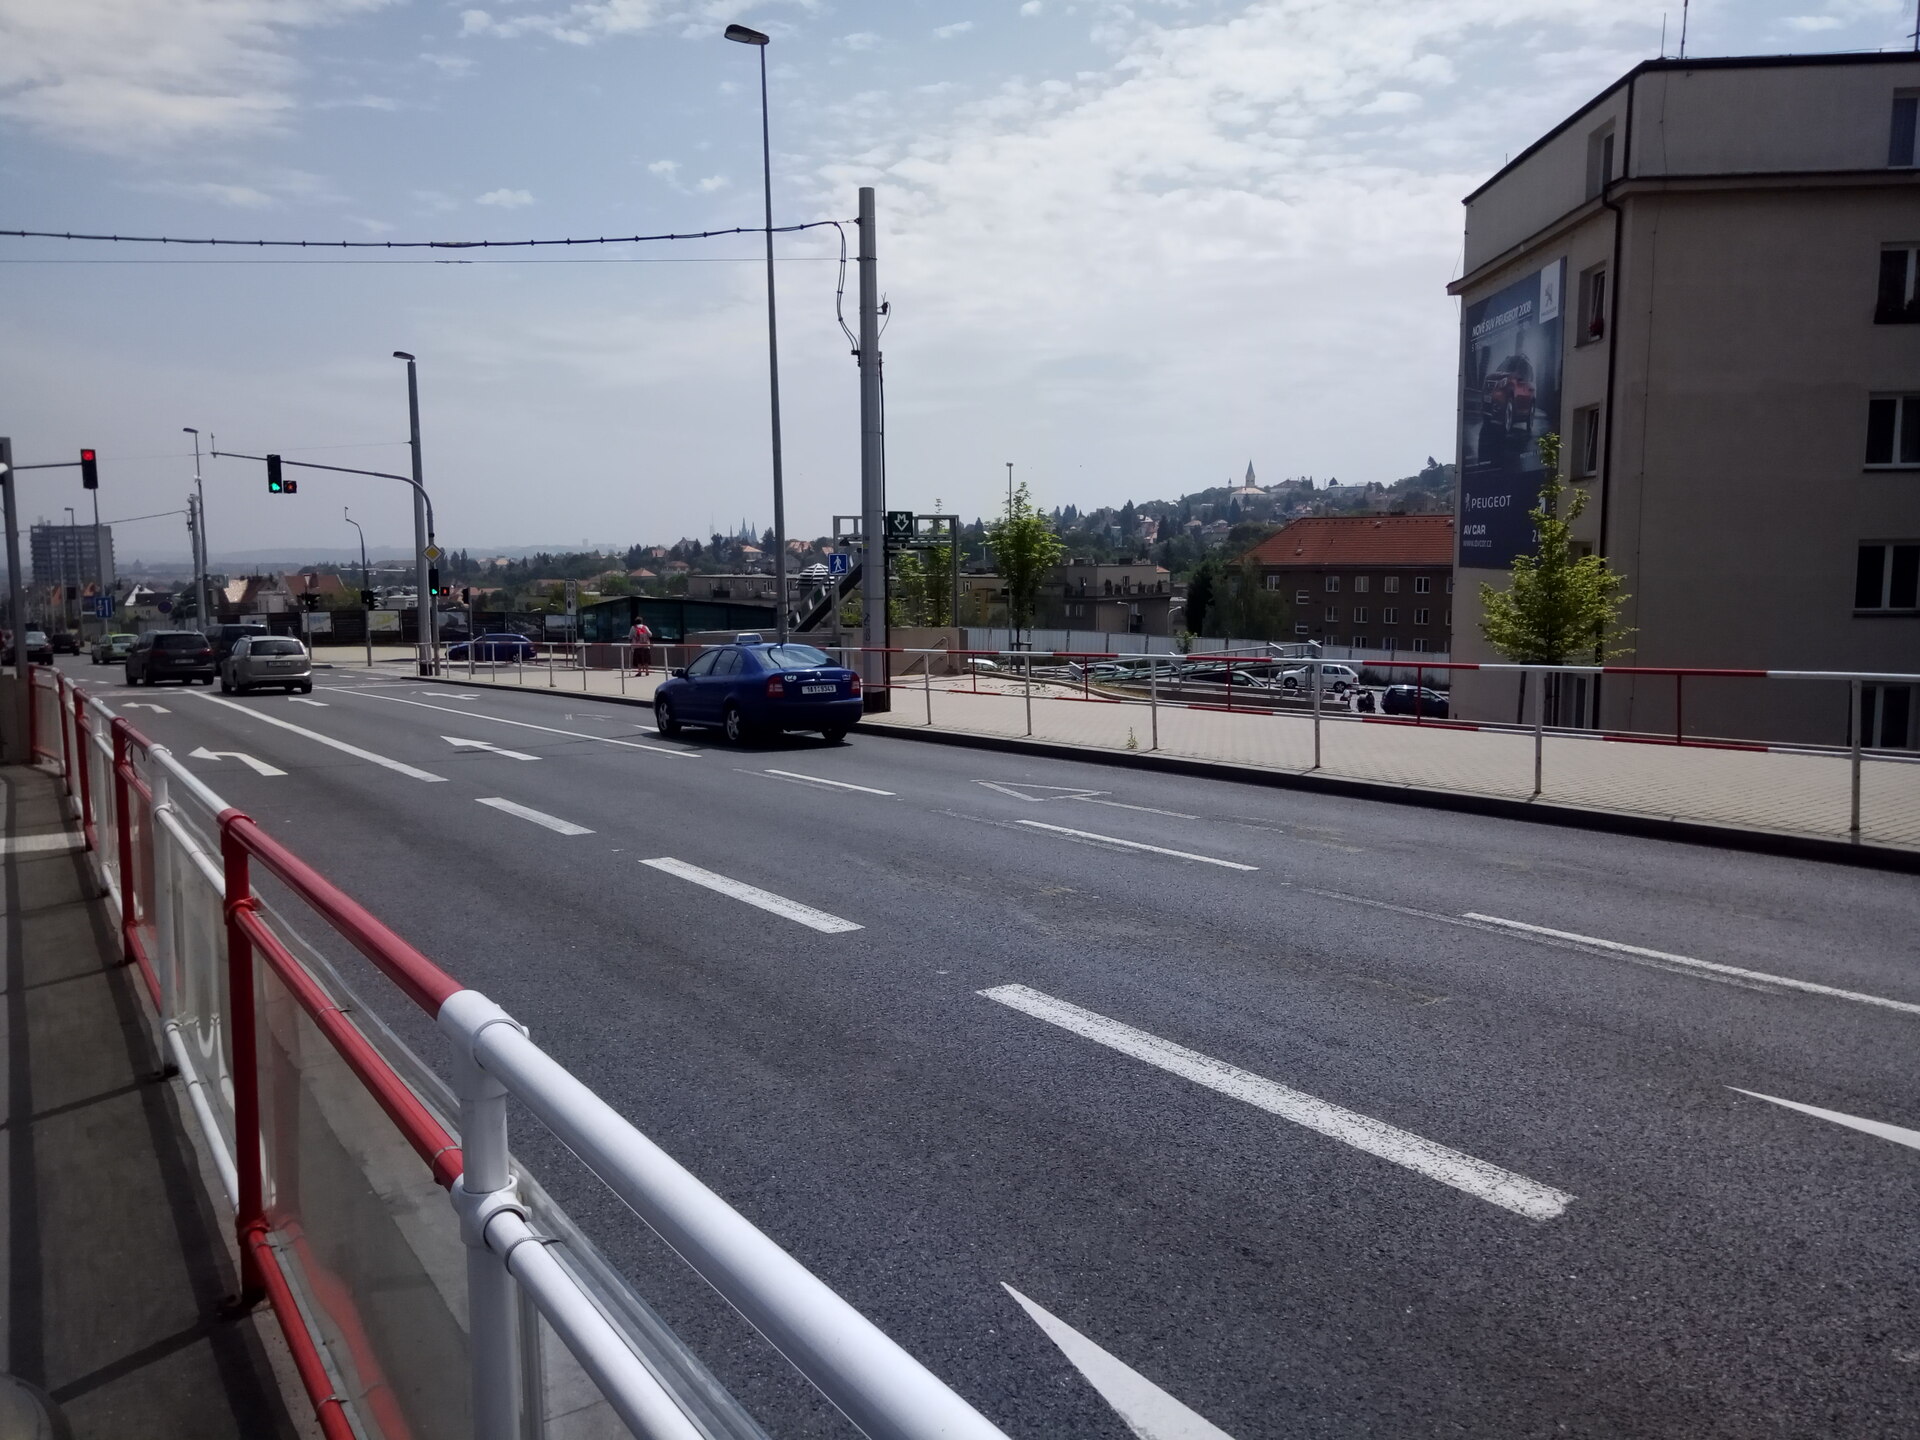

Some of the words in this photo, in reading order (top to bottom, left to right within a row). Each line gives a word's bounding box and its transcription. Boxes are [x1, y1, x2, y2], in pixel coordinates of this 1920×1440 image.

[1496, 306, 1519, 326] PEUGEOT
[1519, 300, 1532, 317] 2008
[1471, 494, 1512, 509] PEUGEOT
[1472, 524, 1486, 535] CAR
